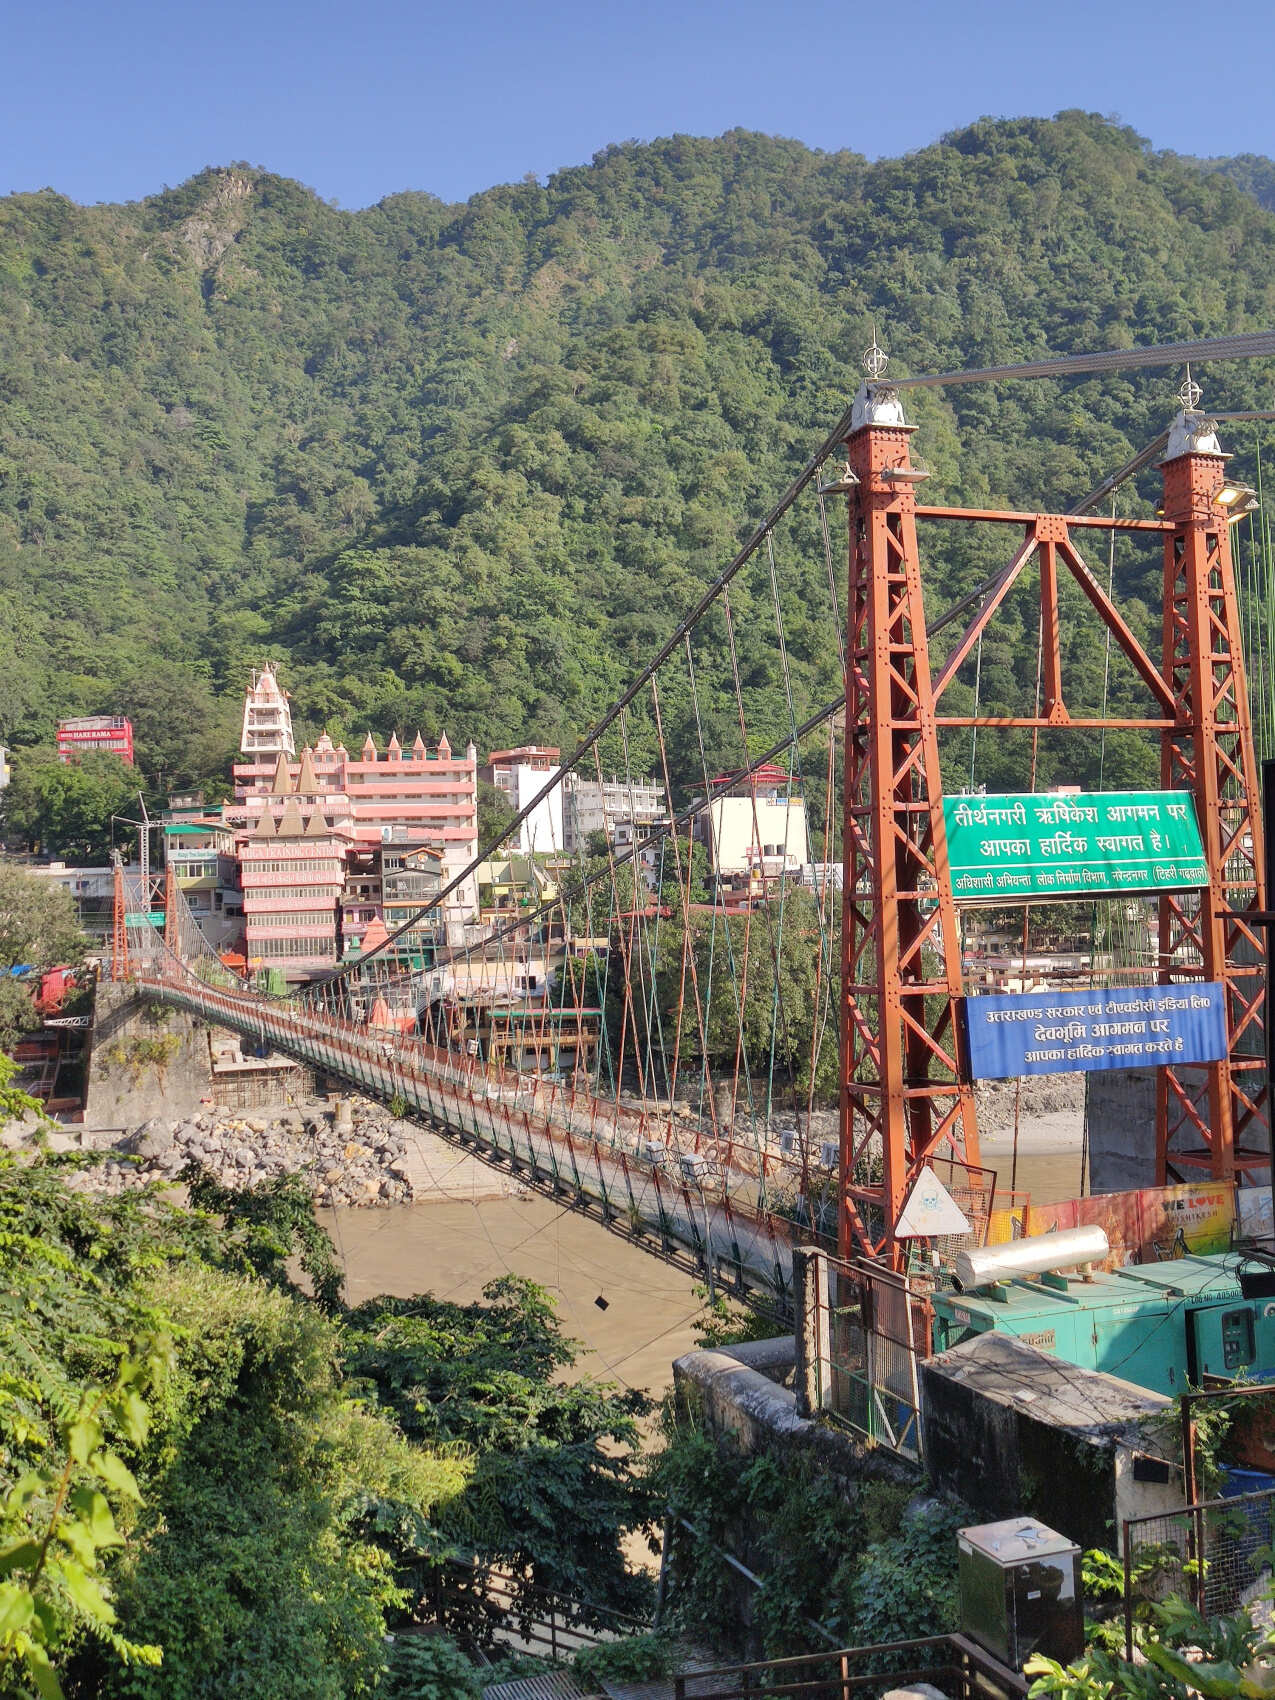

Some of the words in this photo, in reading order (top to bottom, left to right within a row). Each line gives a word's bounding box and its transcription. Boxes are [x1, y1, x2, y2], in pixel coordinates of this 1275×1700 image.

[953, 802, 1026, 826] तीर्थनगरी
[1033, 801, 1099, 824] ऋषिकेश
[1106, 805, 1160, 822] आगमन
[1166, 804, 1187, 820] पर
[980, 839, 1031, 856] आपका
[1038, 831, 1088, 856] हार्दिक
[1095, 835, 1144, 852] स्वागत
[1036, 870, 1055, 885] लोक
[1056, 868, 1081, 885] निर्माण
[985, 1008, 1043, 1023] उत्तराखण्ड
[1045, 1005, 1086, 1018] सरकार
[1087, 1002, 1102, 1016] एवं
[1157, 996, 1188, 1012] इंडिया
[1034, 1021, 1087, 1043] देवभूमि
[1091, 1020, 1146, 1037] आगमन
[1149, 1018, 1171, 1033] पर
[1024, 1049, 1065, 1062] आपका
[1067, 1044, 1105, 1060] हार्दिक
[1105, 1043, 1143, 1056] स्वागत
[1145, 1038, 1172, 1053] करते
[1161, 1200, 1185, 1212] WE
